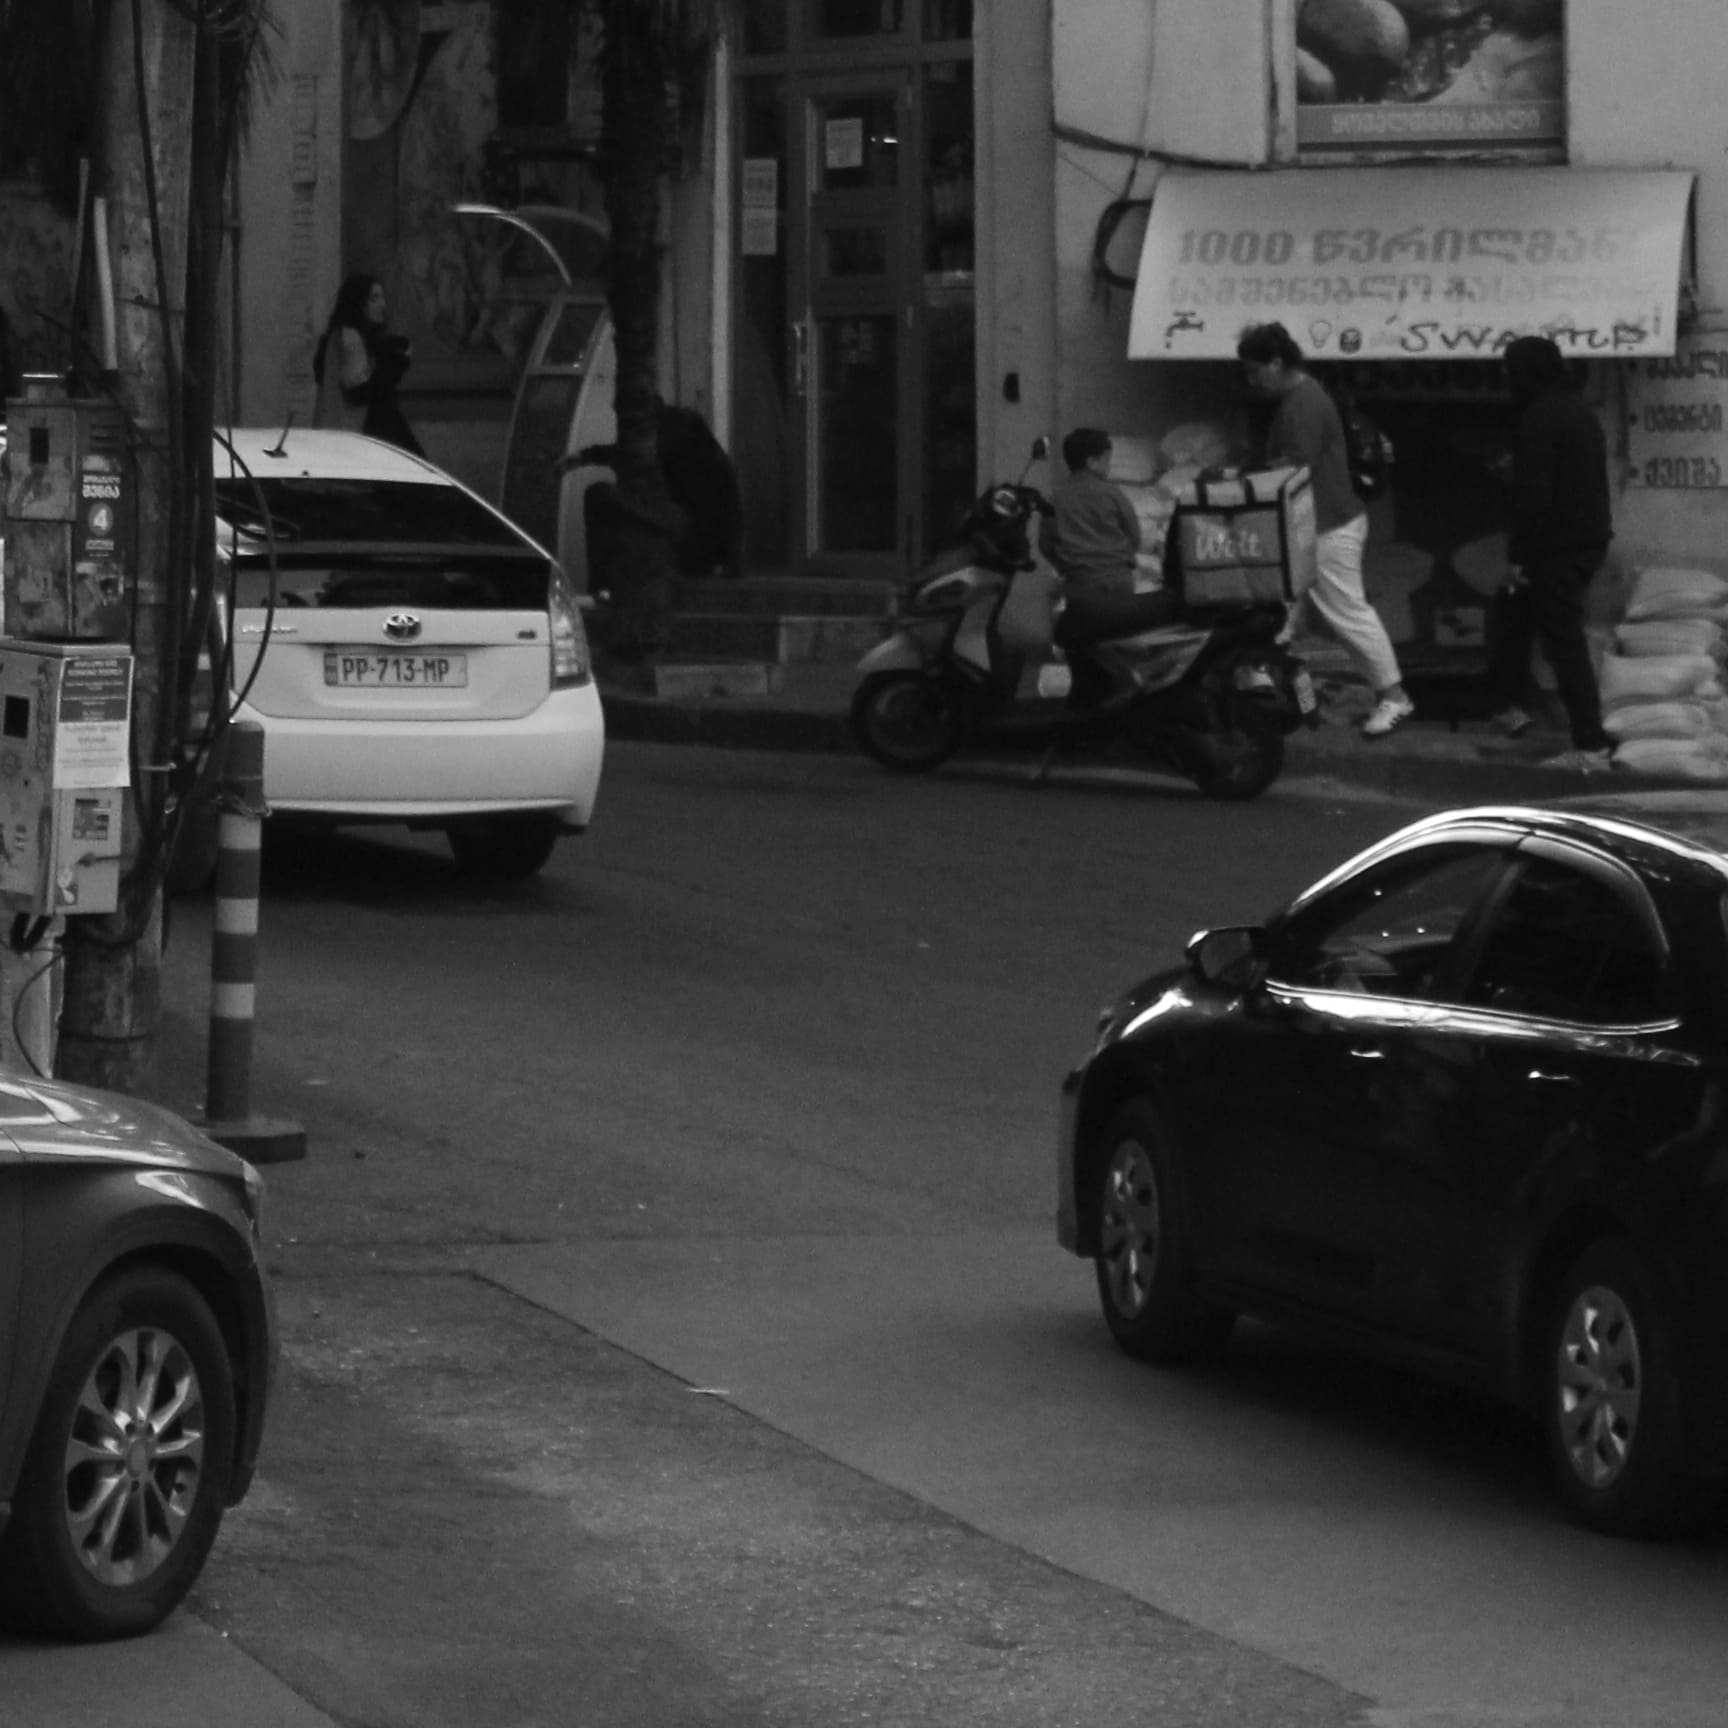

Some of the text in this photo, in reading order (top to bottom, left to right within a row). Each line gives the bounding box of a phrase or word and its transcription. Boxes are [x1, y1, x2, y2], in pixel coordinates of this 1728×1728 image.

[1178, 229, 1293, 265] 1000
[93, 508, 108, 531] 4
[341, 657, 450, 683] PP-713-MP
